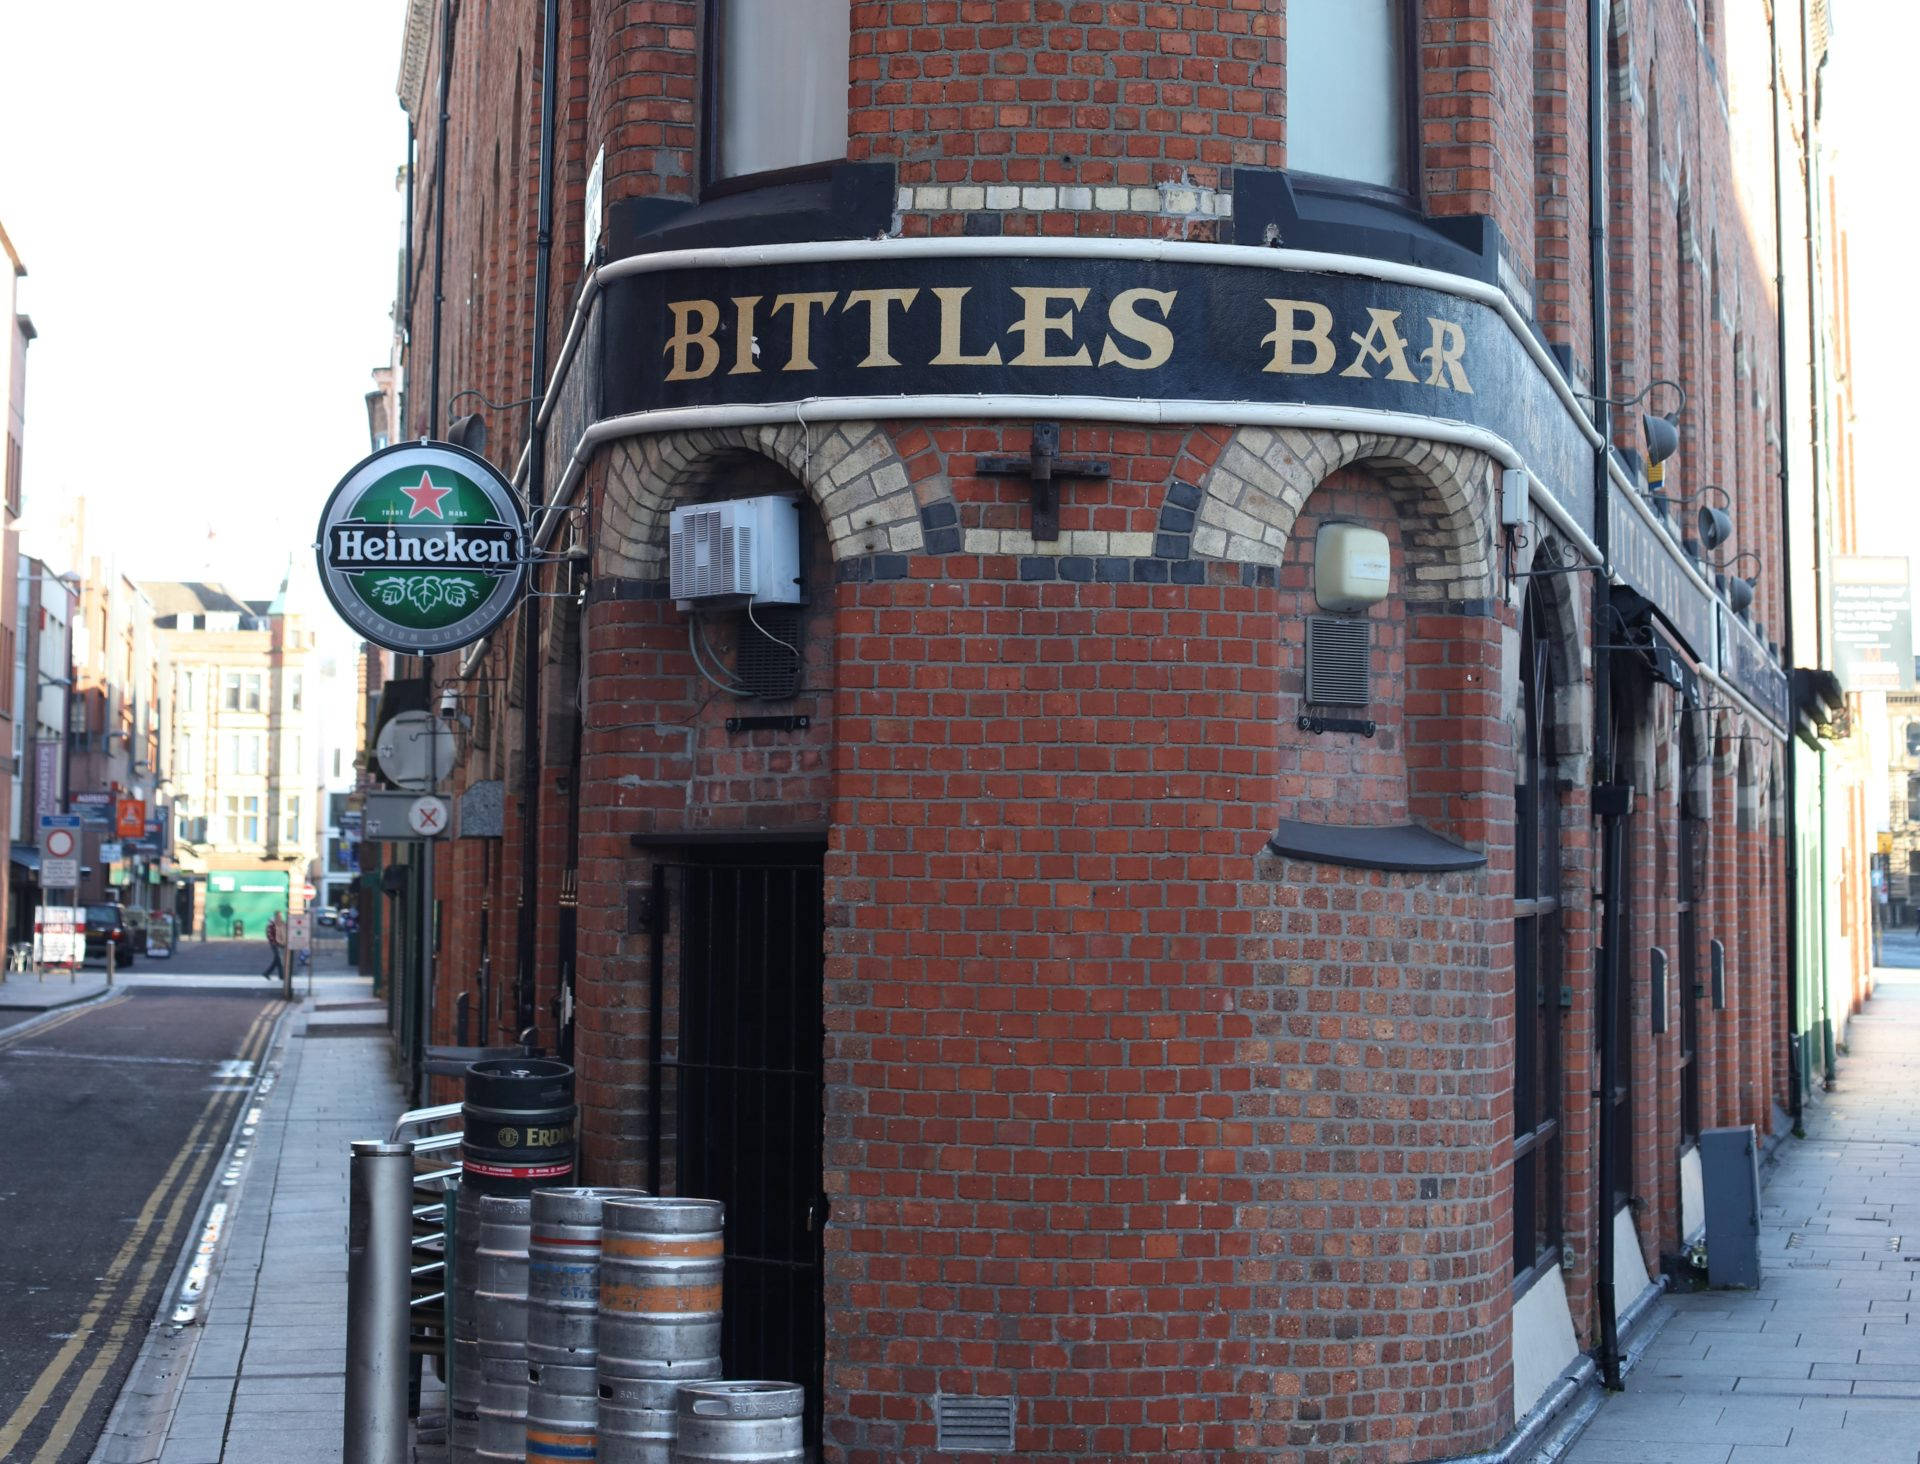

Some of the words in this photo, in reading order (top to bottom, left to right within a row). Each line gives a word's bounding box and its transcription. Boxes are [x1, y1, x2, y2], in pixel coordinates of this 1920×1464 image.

[662, 286, 1179, 382] BITTLES
[1260, 298, 1474, 394] BAR
[337, 530, 511, 562] Heineken
